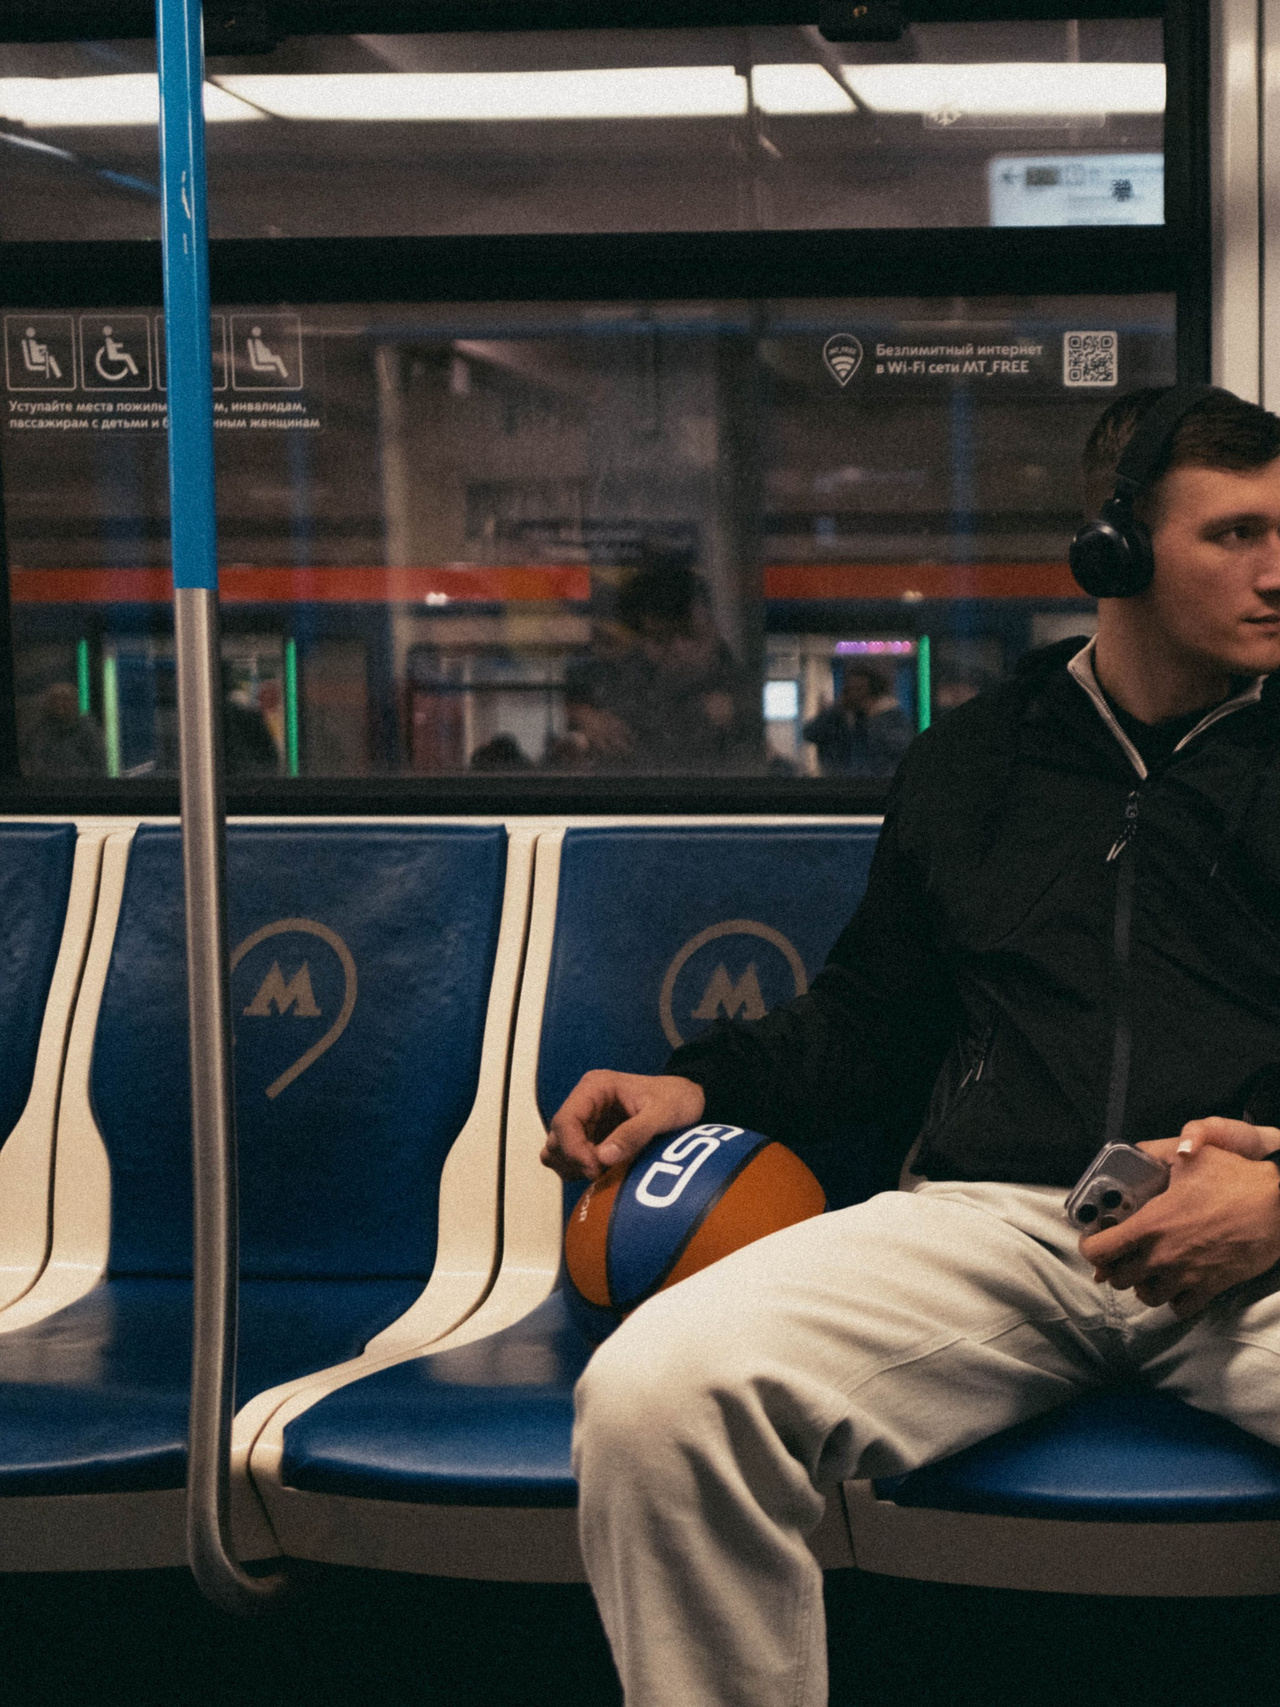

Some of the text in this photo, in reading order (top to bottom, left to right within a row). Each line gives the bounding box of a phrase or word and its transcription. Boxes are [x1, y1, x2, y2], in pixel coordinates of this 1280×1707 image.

[876, 343, 1043, 356] Безлимитный интернет
[876, 360, 1030, 376] в Wi-Fi сети MT_FREE
[9, 400, 73, 415] Уступайте
[76, 402, 114, 412] места
[117, 401, 167, 412] пожилы
[231, 401, 307, 413] инвалидам,
[9, 418, 89, 430] пассажирам
[91, 419, 99, 428] с
[101, 418, 148, 429] детьми
[151, 418, 159, 428] и
[249, 418, 320, 430] женщинам
